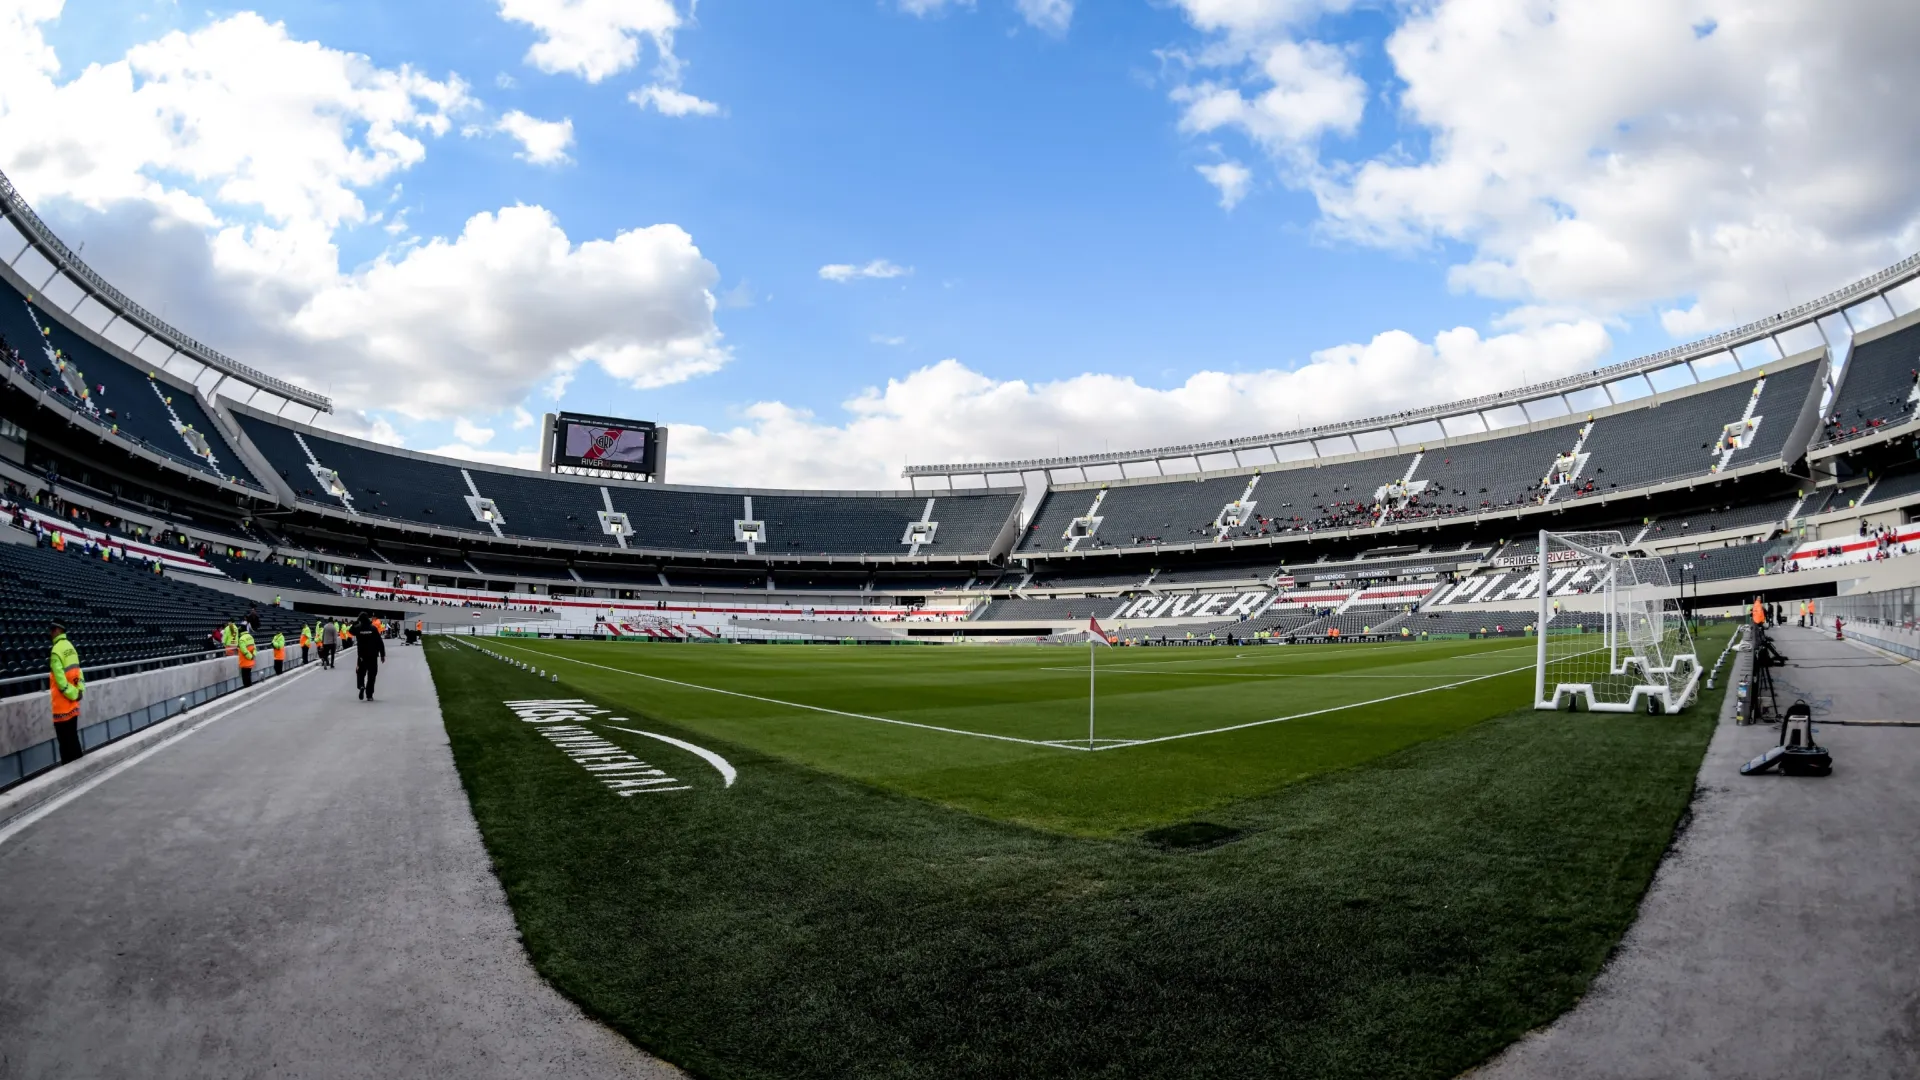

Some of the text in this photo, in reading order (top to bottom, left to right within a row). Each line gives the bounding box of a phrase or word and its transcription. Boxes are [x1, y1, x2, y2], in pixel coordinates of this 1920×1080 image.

[596, 435, 614, 449] CARP
[1503, 546, 1603, 566] PRIMERRIVER.CM
[1314, 573, 1346, 581] BIENVENIDOS
[1358, 570, 1390, 578] BIENVENIDOS
[1402, 566, 1435, 574] BIENVENIDOS
[1439, 563, 1607, 605] PLATE
[1125, 591, 1268, 619] RIVER
